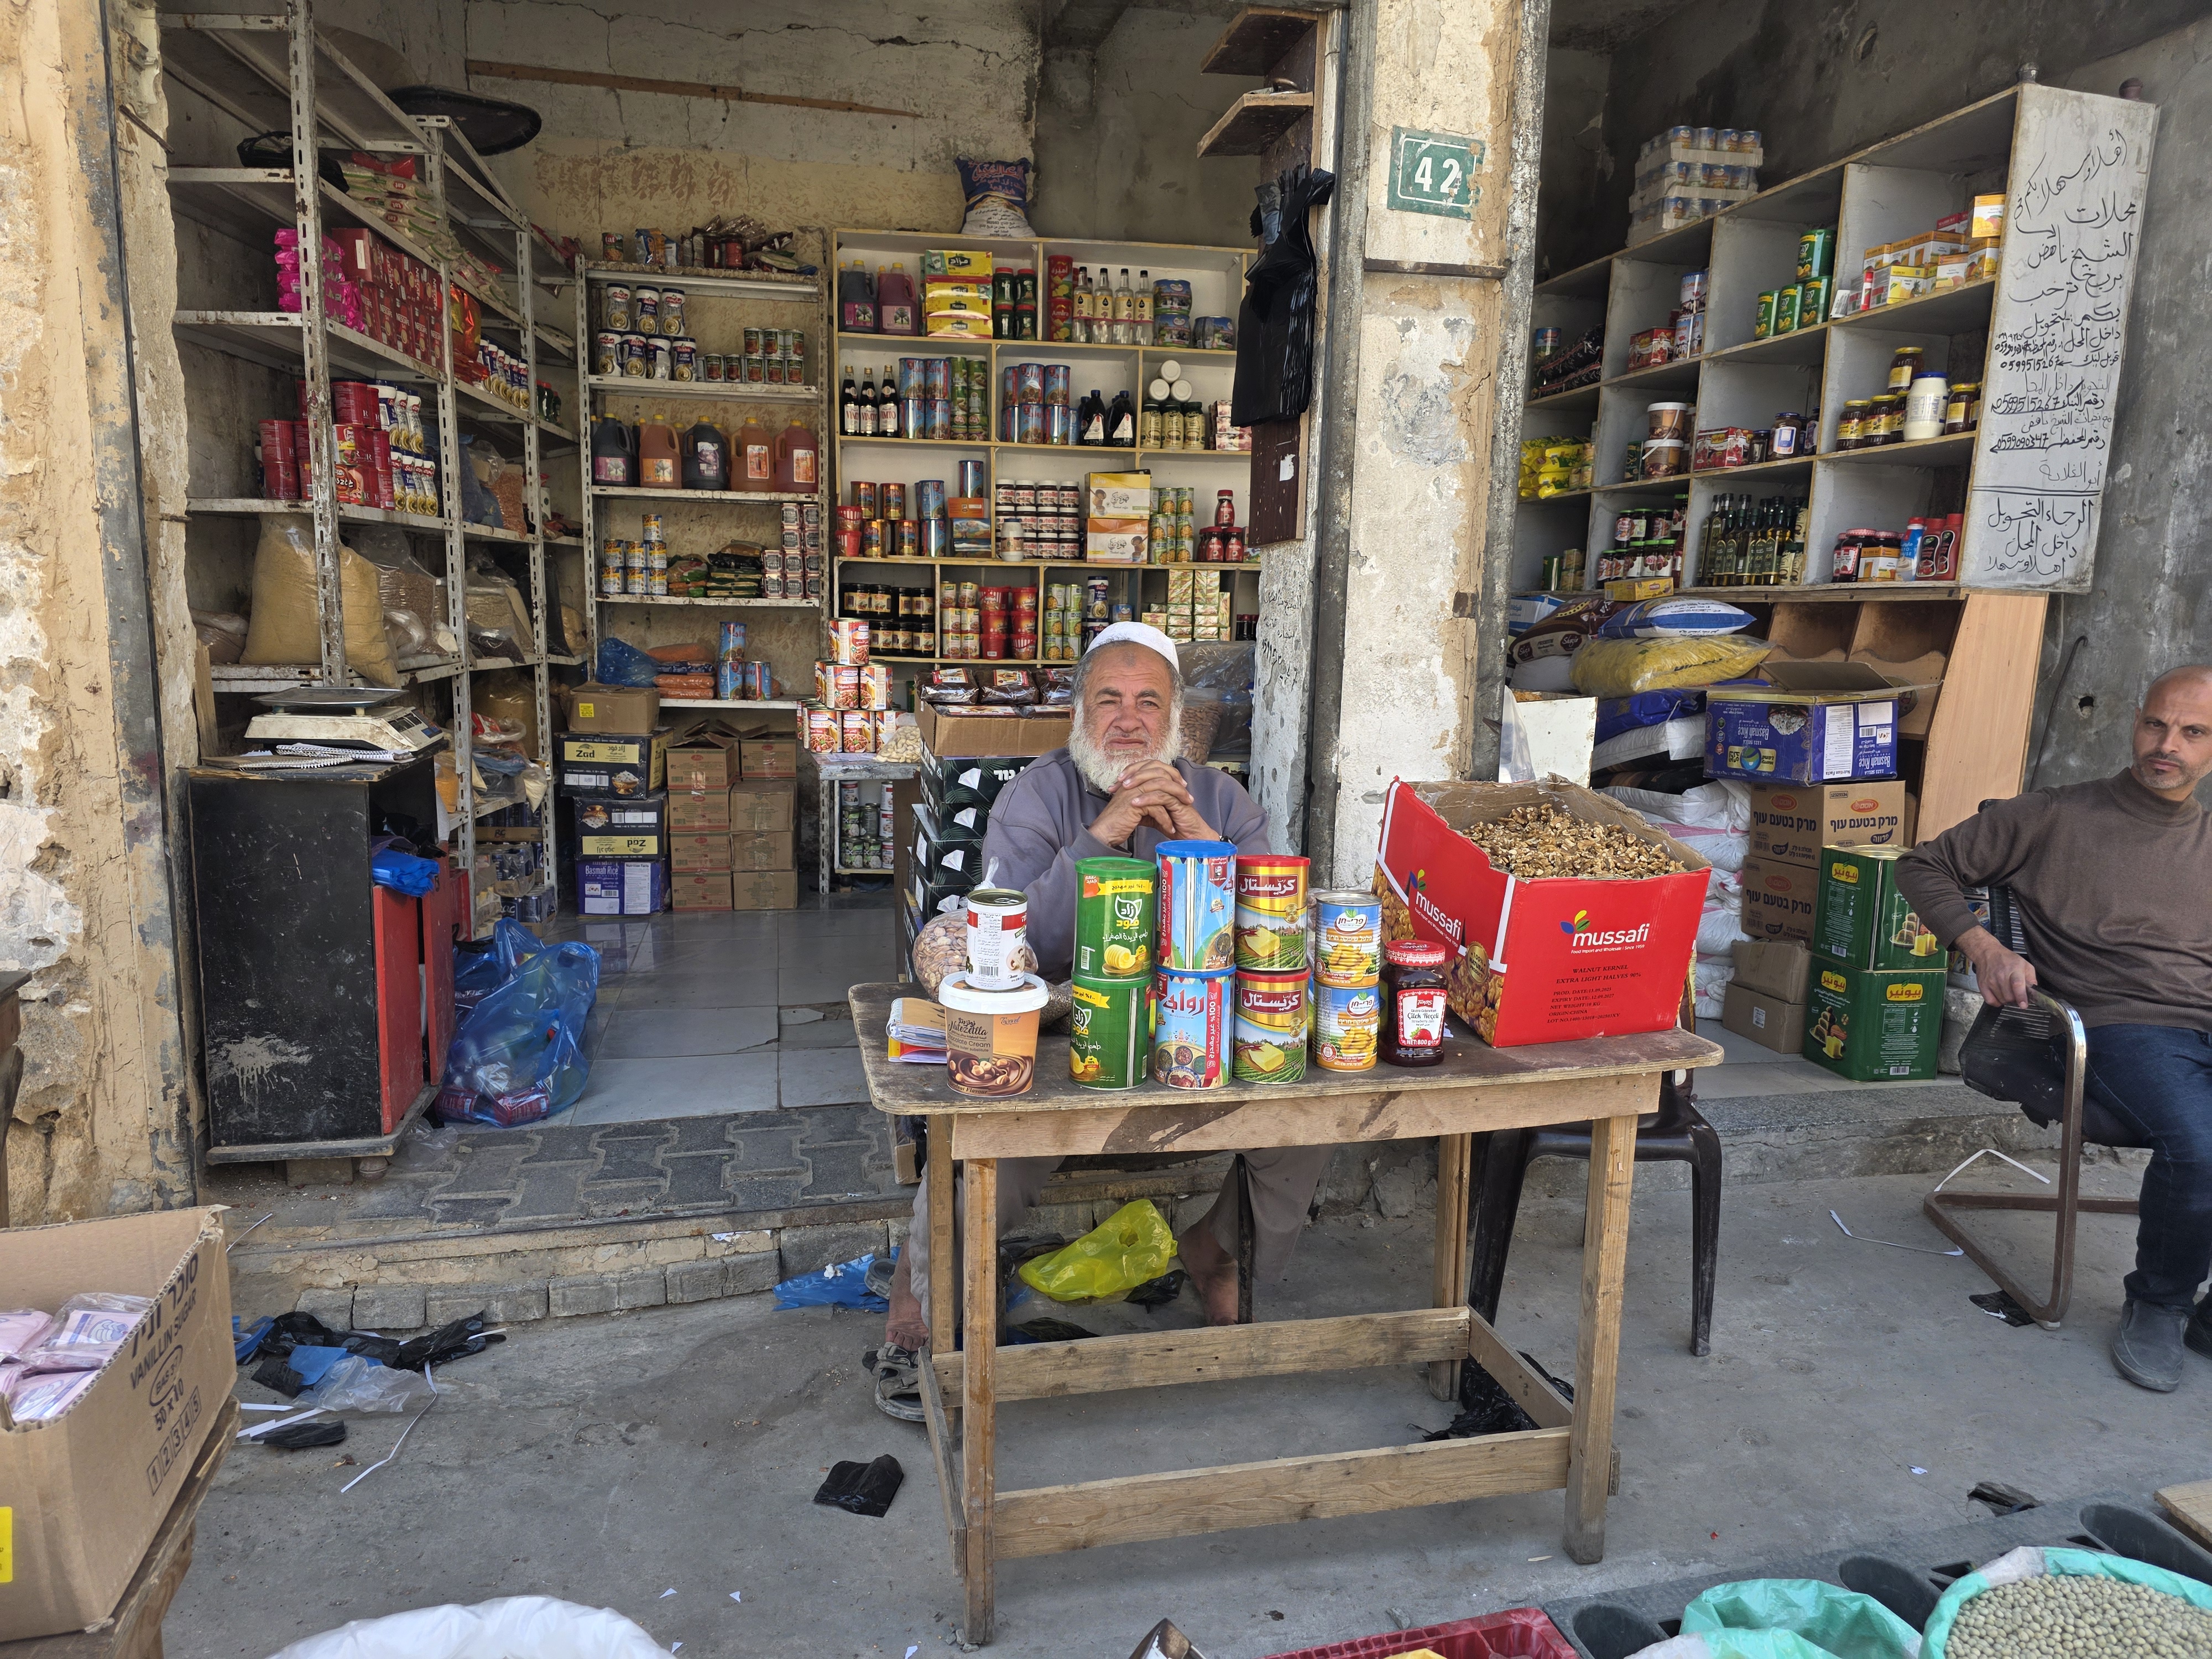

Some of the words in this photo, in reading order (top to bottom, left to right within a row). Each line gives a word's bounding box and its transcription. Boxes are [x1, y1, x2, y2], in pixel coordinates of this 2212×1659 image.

[1415, 156, 1459, 194] 42
[2070, 232, 2133, 281] الشيخ
[1988, 497, 2043, 531] التحويل
[2046, 498, 2094, 539] الرجاء
[2042, 534, 2077, 558] داخل
[1738, 726, 1749, 738] Rice
[1749, 727, 1769, 740] Basmati
[1859, 758, 1870, 770] Rice
[1870, 755, 1891, 769] Basmati
[1754, 811, 1767, 826] עוף
[1769, 813, 1794, 828] בטעם
[1797, 818, 1817, 832] מרק
[1830, 819, 1847, 833] עוף
[1849, 817, 1876, 828] בטעם
[1878, 816, 1898, 829] מרק
[1872, 833, 1889, 843] פרווה
[585, 865, 607, 875] Basmati
[607, 865, 618, 875] Rice
[1834, 867, 1859, 883] بيونير
[1239, 878, 1296, 896] كريستال
[1746, 889, 1761, 904] עוף
[1764, 894, 1789, 910] בטעם
[1121, 903, 1134, 917] زاد
[1792, 899, 1812, 915] מרק
[1416, 891, 1462, 940] mussafi
[1572, 923, 1650, 947] mussafi
[1469, 958, 1485, 975] NATURAL
[1822, 975, 1846, 992] بيونير
[1244, 993, 1300, 1010] كريستال
[1887, 988, 1922, 999] بيونير
[168, 1252, 199, 1311] סוכר
[131, 1324, 173, 1390] VANILLIN
[174, 1287, 197, 1337] SUGAR
